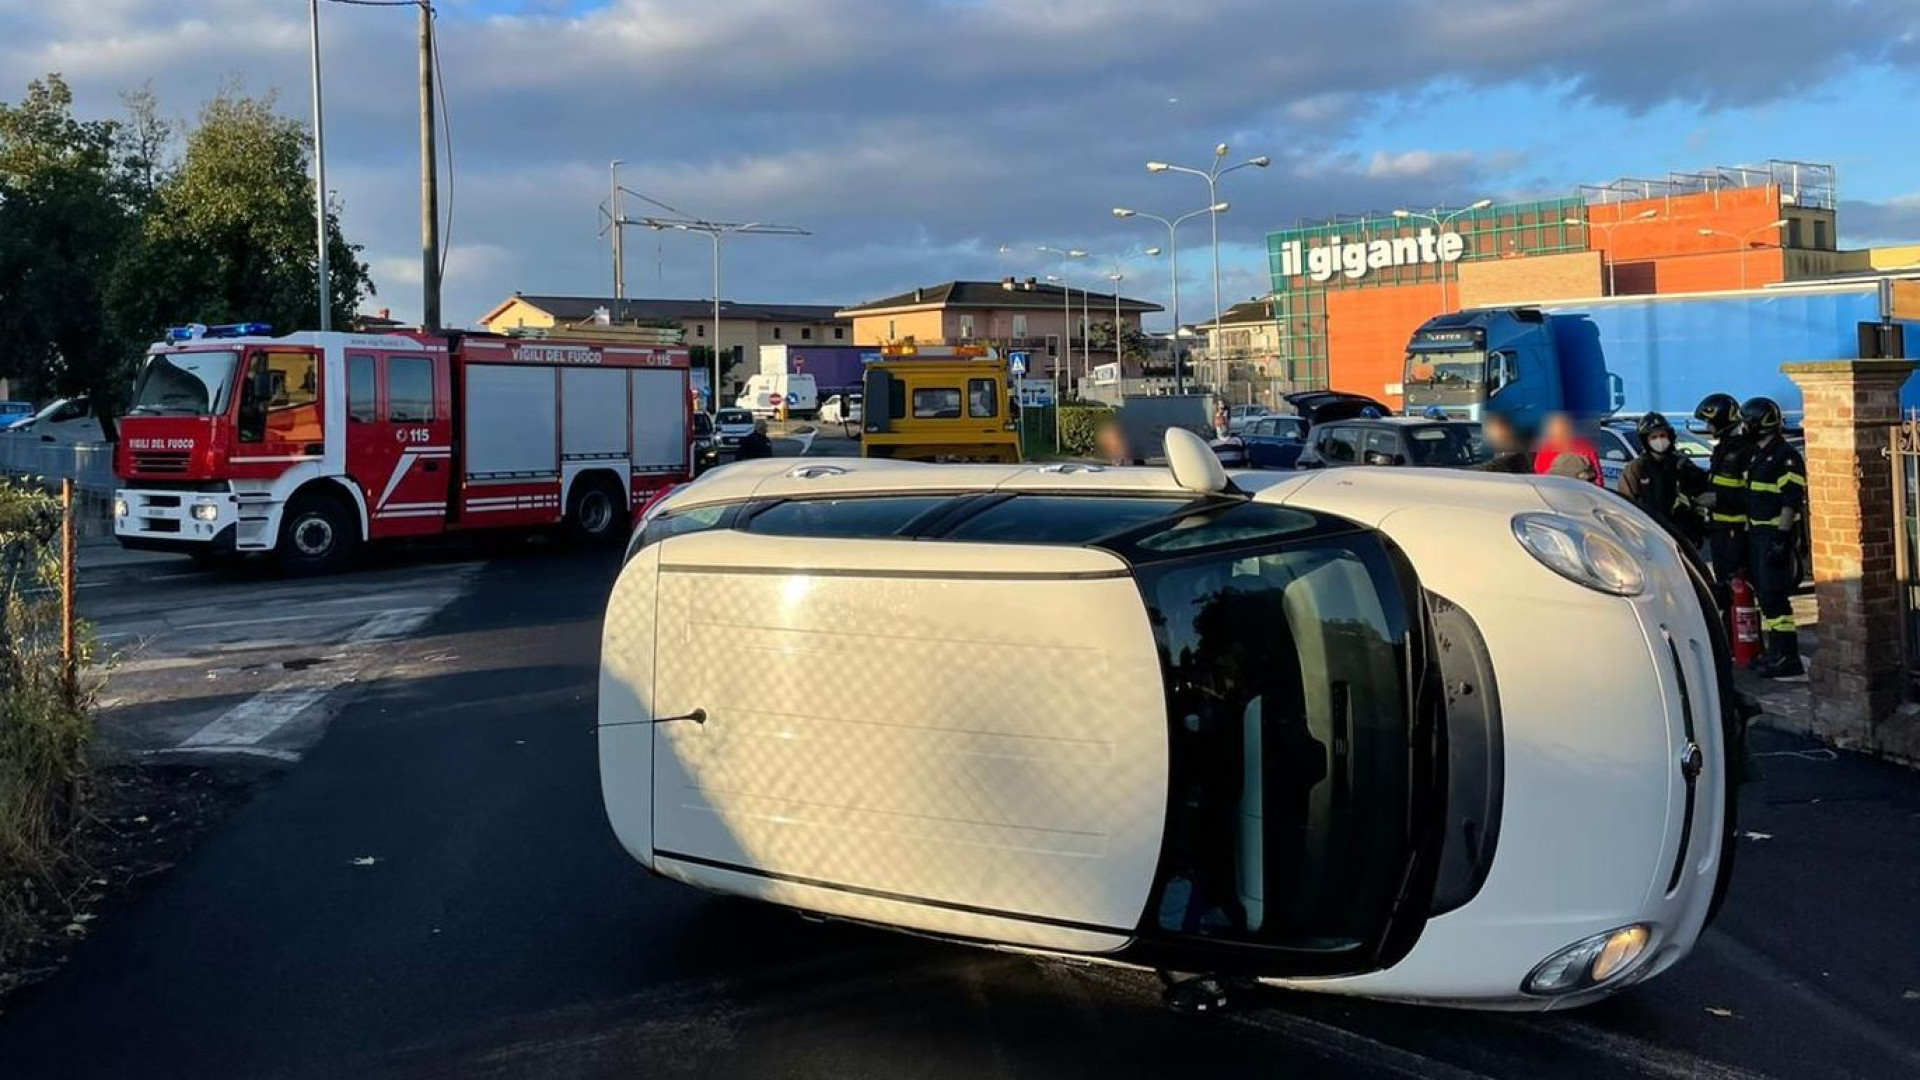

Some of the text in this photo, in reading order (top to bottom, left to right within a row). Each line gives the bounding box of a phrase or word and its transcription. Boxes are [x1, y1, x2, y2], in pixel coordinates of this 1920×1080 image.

[1282, 227, 1464, 281] il gigante
[511, 348, 603, 364] VIGILI DEL FUOCO
[657, 353, 672, 366] 115
[410, 428, 430, 442] 115
[129, 437, 195, 449] VIGILI DEL FUOCO
